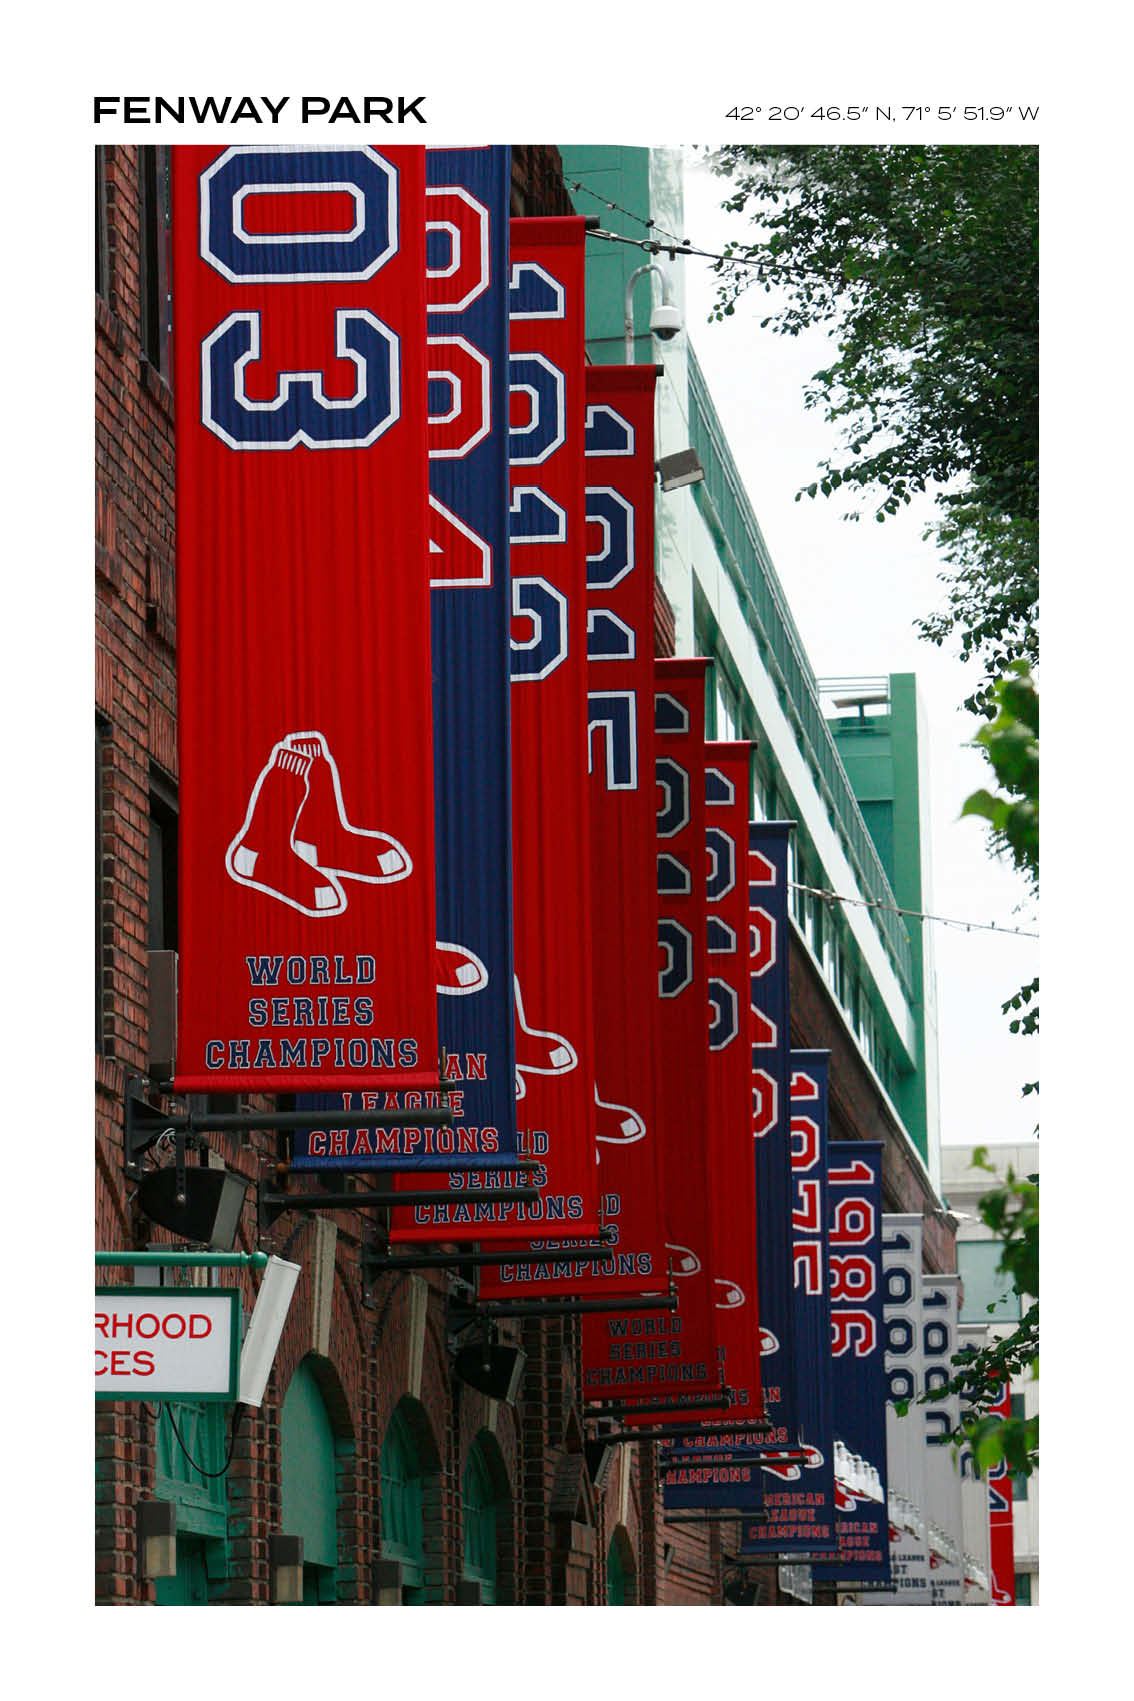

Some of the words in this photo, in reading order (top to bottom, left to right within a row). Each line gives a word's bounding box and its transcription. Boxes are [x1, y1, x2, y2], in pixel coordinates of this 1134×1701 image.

[246, 955, 376, 986] WORLD
[249, 997, 374, 1027] SERIES
[205, 1038, 419, 1070] CHAMPIONS
[308, 1127, 499, 1156] CHAMPIONS
[448, 1164, 548, 1190] SERIES
[414, 1195, 584, 1224] CHAMPIONS
[500, 1253, 653, 1282] CHAMPIONS
[827, 1160, 877, 1358] 1986
[608, 1317, 682, 1337] WORLD
[609, 1340, 681, 1361] SERIES
[586, 1363, 707, 1386] CHAMPIONS
[662, 1467, 751, 1485] HAMPIONS
[765, 1492, 824, 1506] MERICAN
[768, 1508, 815, 1523] EAGUE
